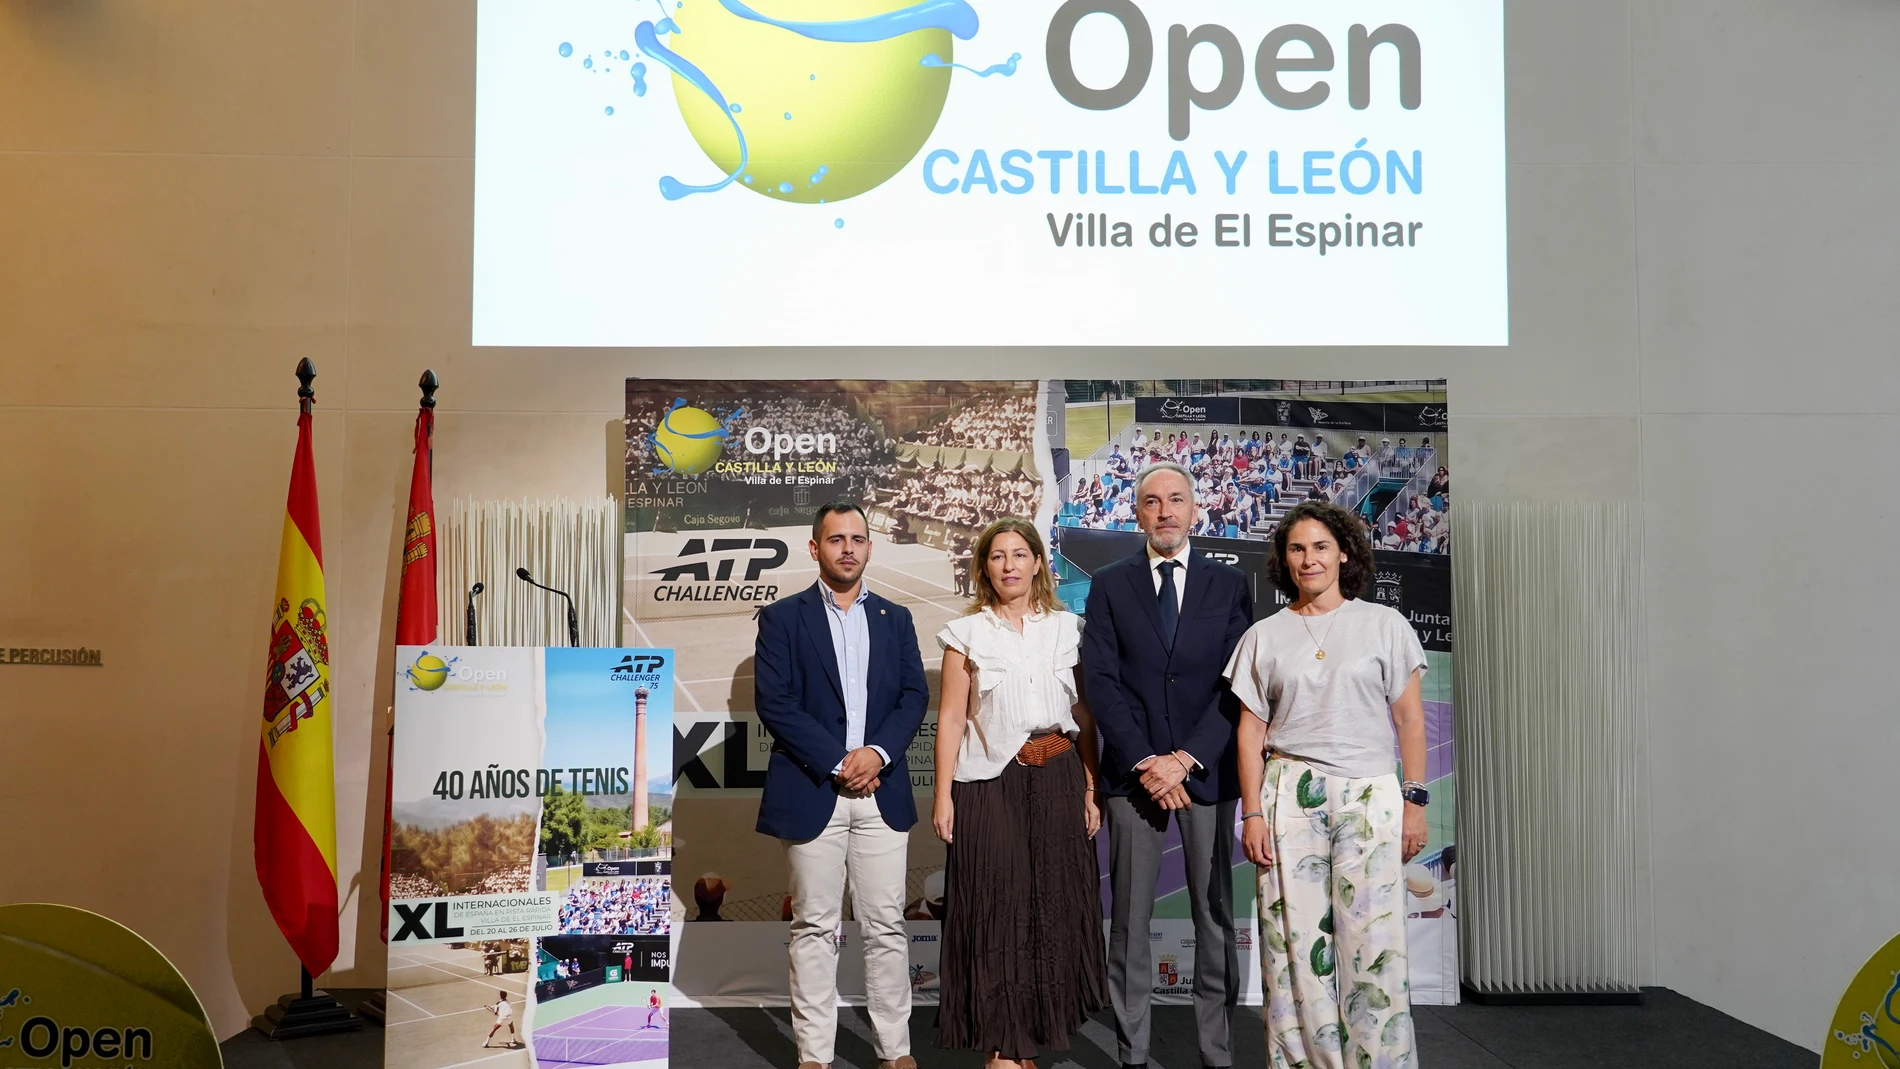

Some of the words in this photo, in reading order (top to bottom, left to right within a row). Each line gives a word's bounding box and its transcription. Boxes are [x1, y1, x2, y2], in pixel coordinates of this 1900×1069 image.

[1044, 0, 1422, 141] Open
[922, 149, 1197, 196] CASTILLA
[1214, 149, 1249, 196] Y
[1269, 137, 1423, 196] LEÓN
[1046, 213, 1133, 248] Villa
[1147, 213, 1199, 248] de
[1213, 213, 1250, 248] El
[1266, 213, 1423, 255] Espinar
[1183, 406, 1206, 414] Open
[744, 426, 836, 460] Open
[715, 462, 782, 473] CASTILLA
[785, 462, 794, 473] Y
[798, 460, 836, 473] LEÓN
[653, 482, 662, 494] Y
[745, 476, 766, 485] Villa
[769, 476, 782, 485] de
[785, 476, 794, 485] El
[798, 476, 835, 486] Espinar
[628, 497, 684, 508] ESPINAR
[648, 538, 788, 581] ATP
[654, 585, 779, 601] CHALLENGER
[752, 606, 764, 620] 7
[1407, 610, 1450, 625] Junta
[1422, 630, 1432, 643] y
[10, 647, 101, 664] PERCUSIÓN
[610, 655, 664, 672] ATP
[459, 666, 507, 684] Open
[673, 722, 768, 788] XL
[433, 771, 464, 800] 40
[469, 764, 530, 799] AÑOS
[536, 769, 563, 798] DE
[569, 767, 629, 796] TENIS
[453, 897, 551, 910] INTERNACIONALES
[392, 902, 464, 942] XL
[612, 942, 634, 950] ATP
[20, 1016, 151, 1067] Open
